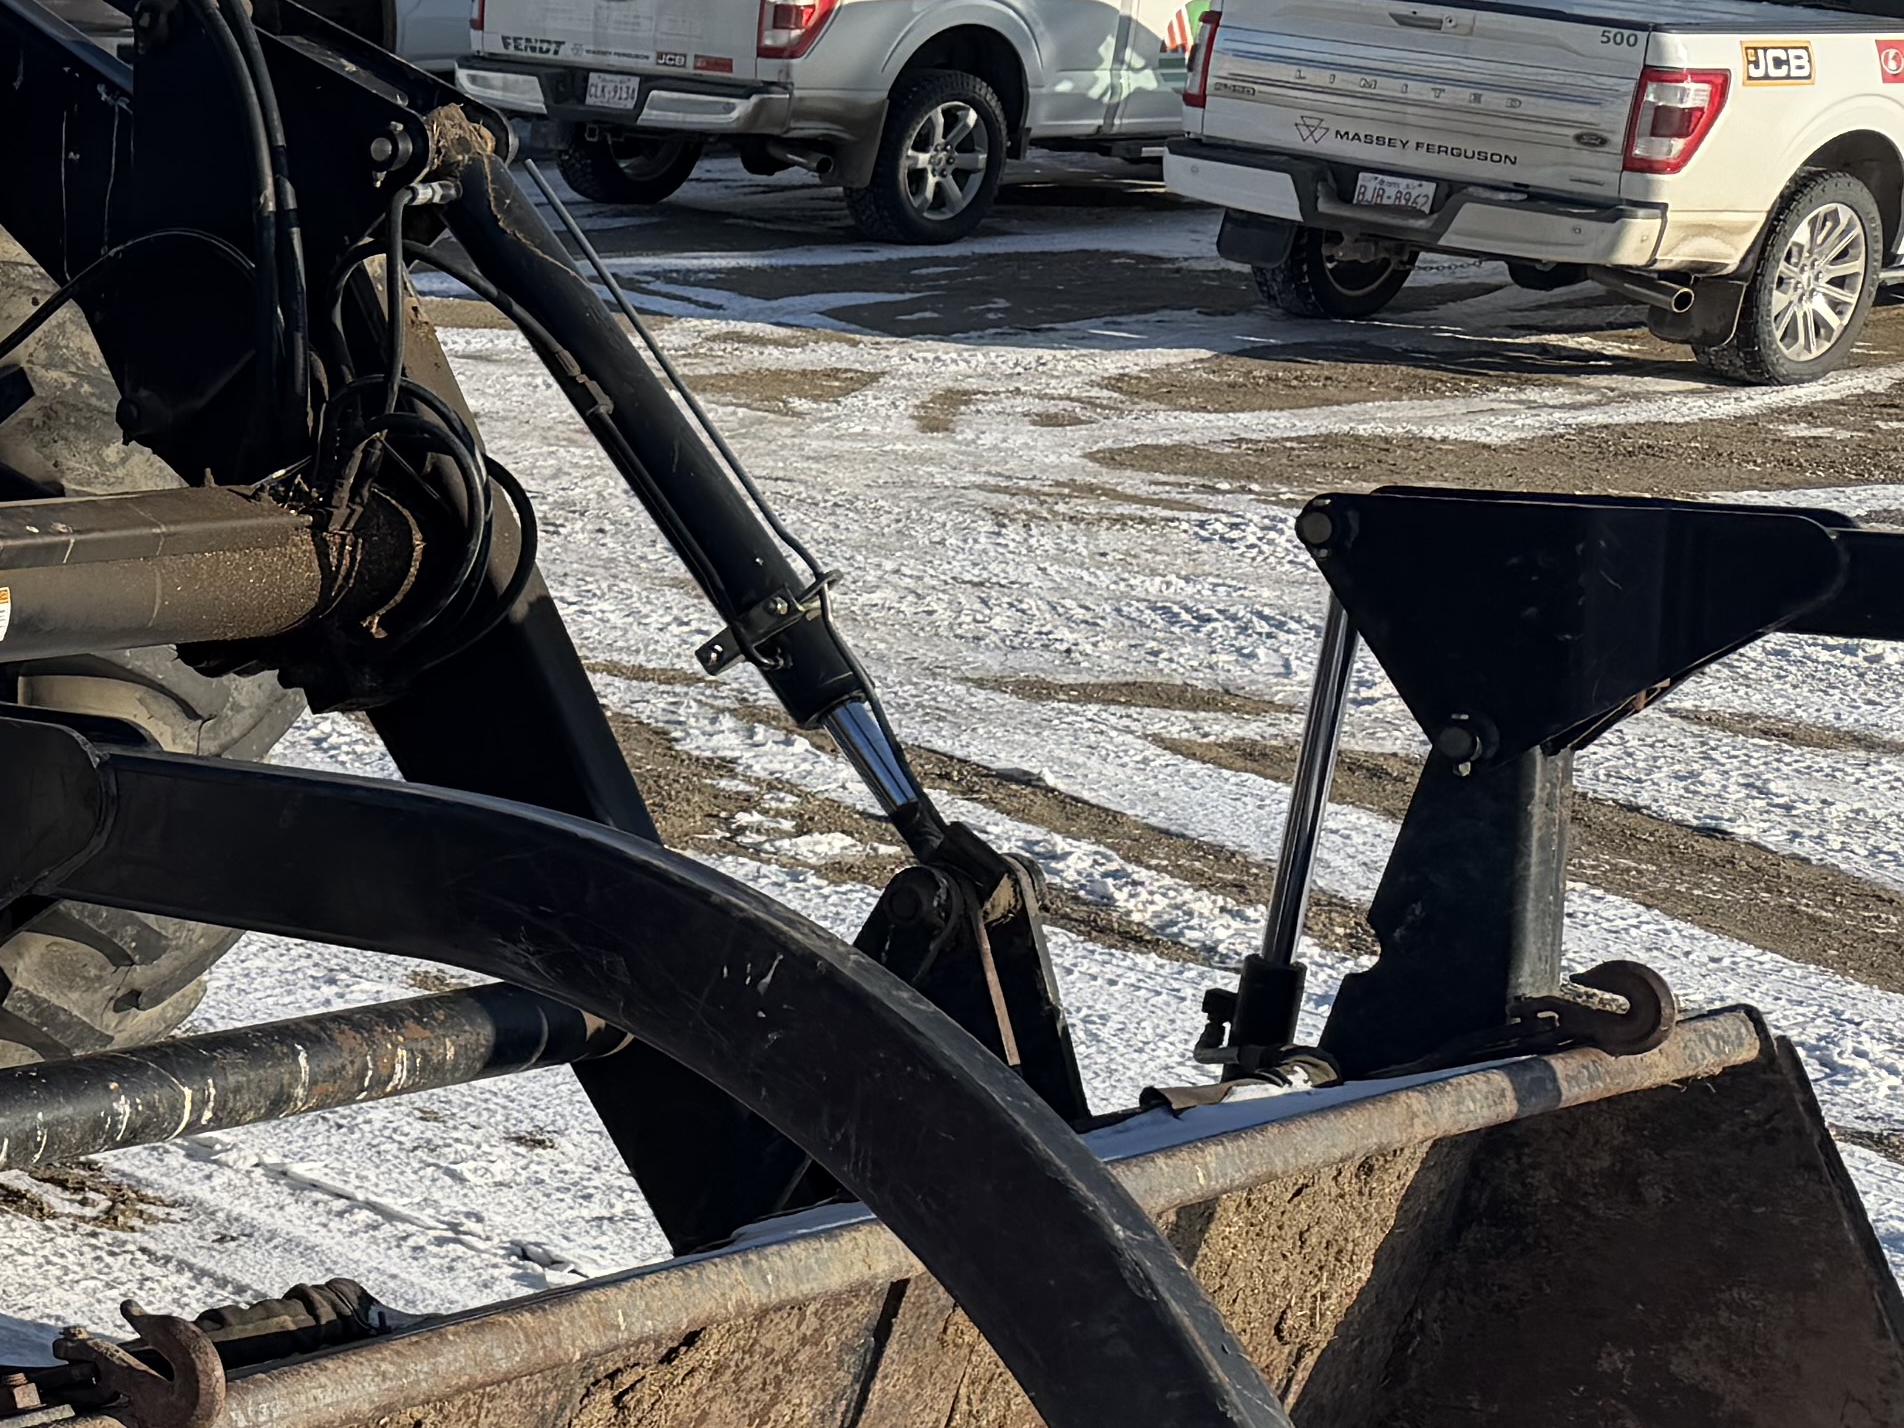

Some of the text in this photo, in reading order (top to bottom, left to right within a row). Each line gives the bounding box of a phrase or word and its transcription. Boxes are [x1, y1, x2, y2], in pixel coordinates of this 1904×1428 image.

[501, 35, 566, 56] FENDT
[1600, 30, 1638, 47] 500
[657, 53, 685, 66] JCB
[1748, 48, 1811, 78] JCB
[1294, 69, 1523, 109] LIMITED
[1335, 129, 1518, 166] MASSEY FERGUSON
